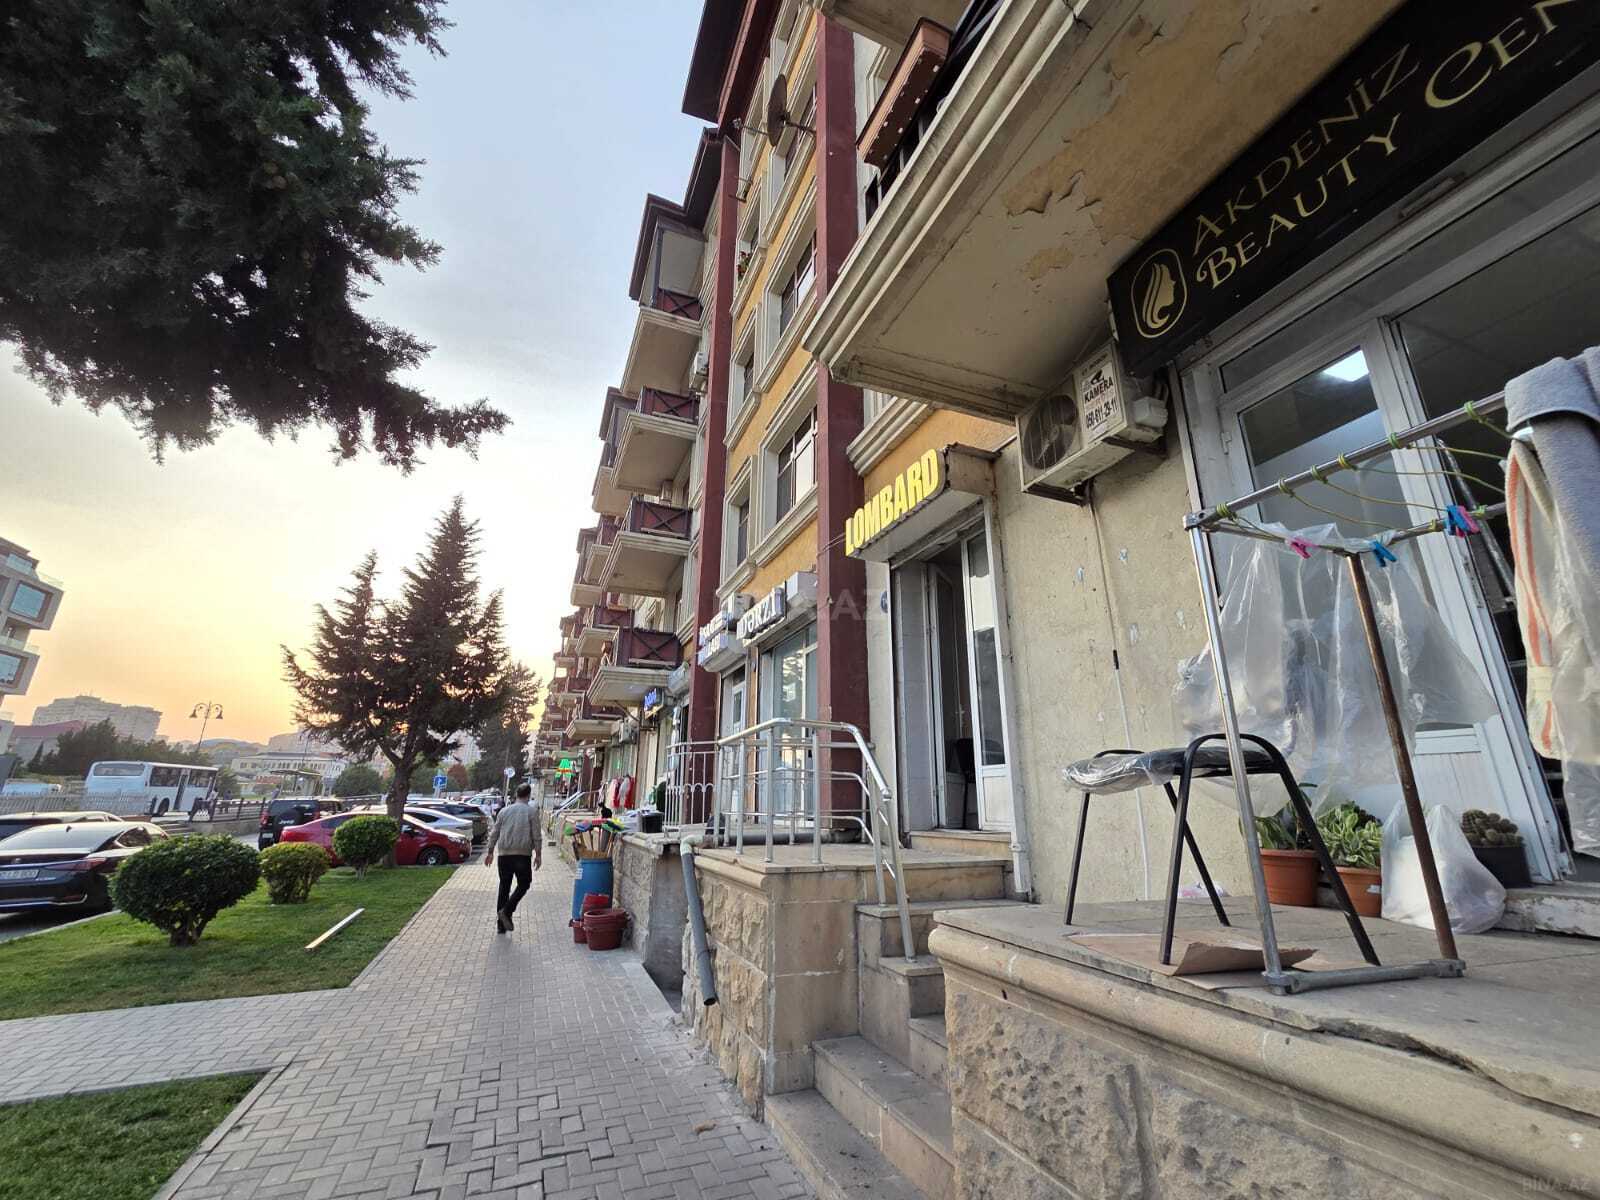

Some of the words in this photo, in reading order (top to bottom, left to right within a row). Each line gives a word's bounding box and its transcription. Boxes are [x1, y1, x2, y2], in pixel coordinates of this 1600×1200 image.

[1193, 43, 1420, 256] AKDENİZ
[1196, 112, 1401, 289] BEAUTY
[1084, 376, 1114, 404] KAMERA
[845, 448, 940, 557] LOMBARD
